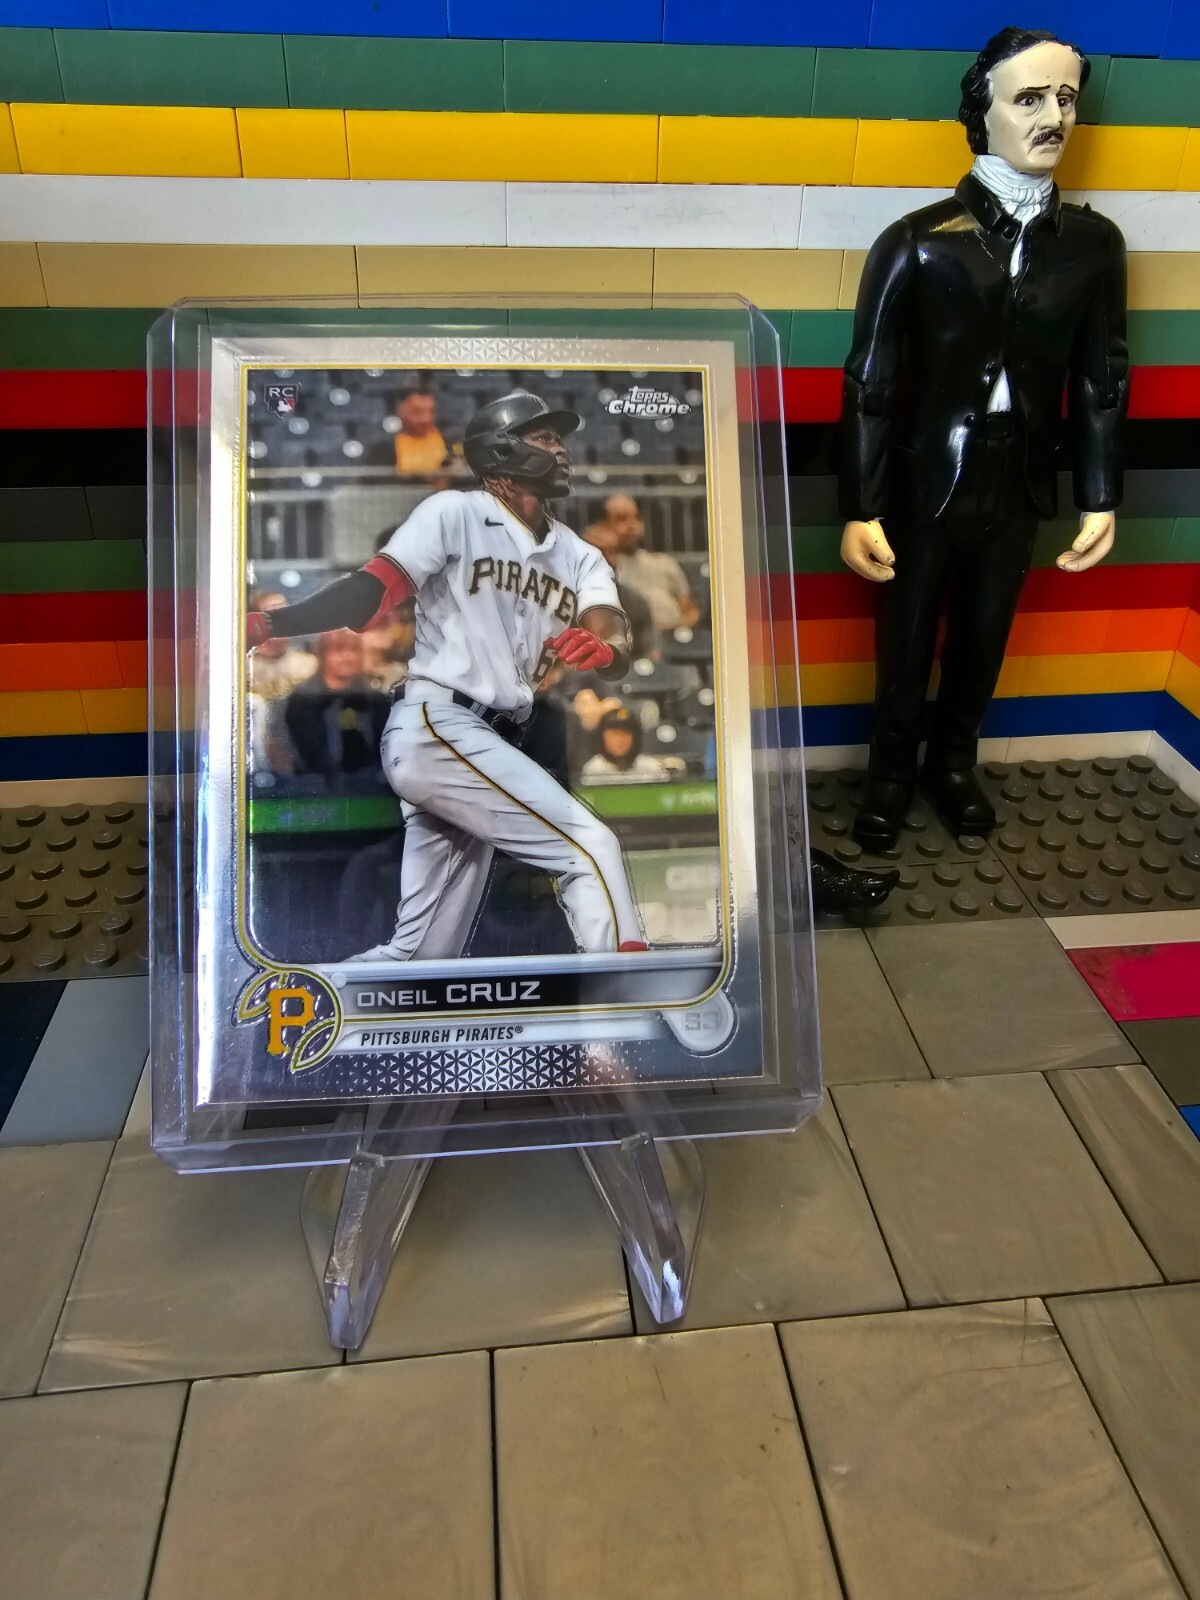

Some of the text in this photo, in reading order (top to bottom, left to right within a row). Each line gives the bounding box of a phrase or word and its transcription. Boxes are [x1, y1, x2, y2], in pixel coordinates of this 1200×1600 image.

[268, 387, 294, 398] RC
[608, 400, 690, 415] Chrome
[357, 981, 541, 1007] ONEIL CRUZ
[267, 985, 316, 1056] P
[360, 1029, 451, 1047] PITTSBURGH
